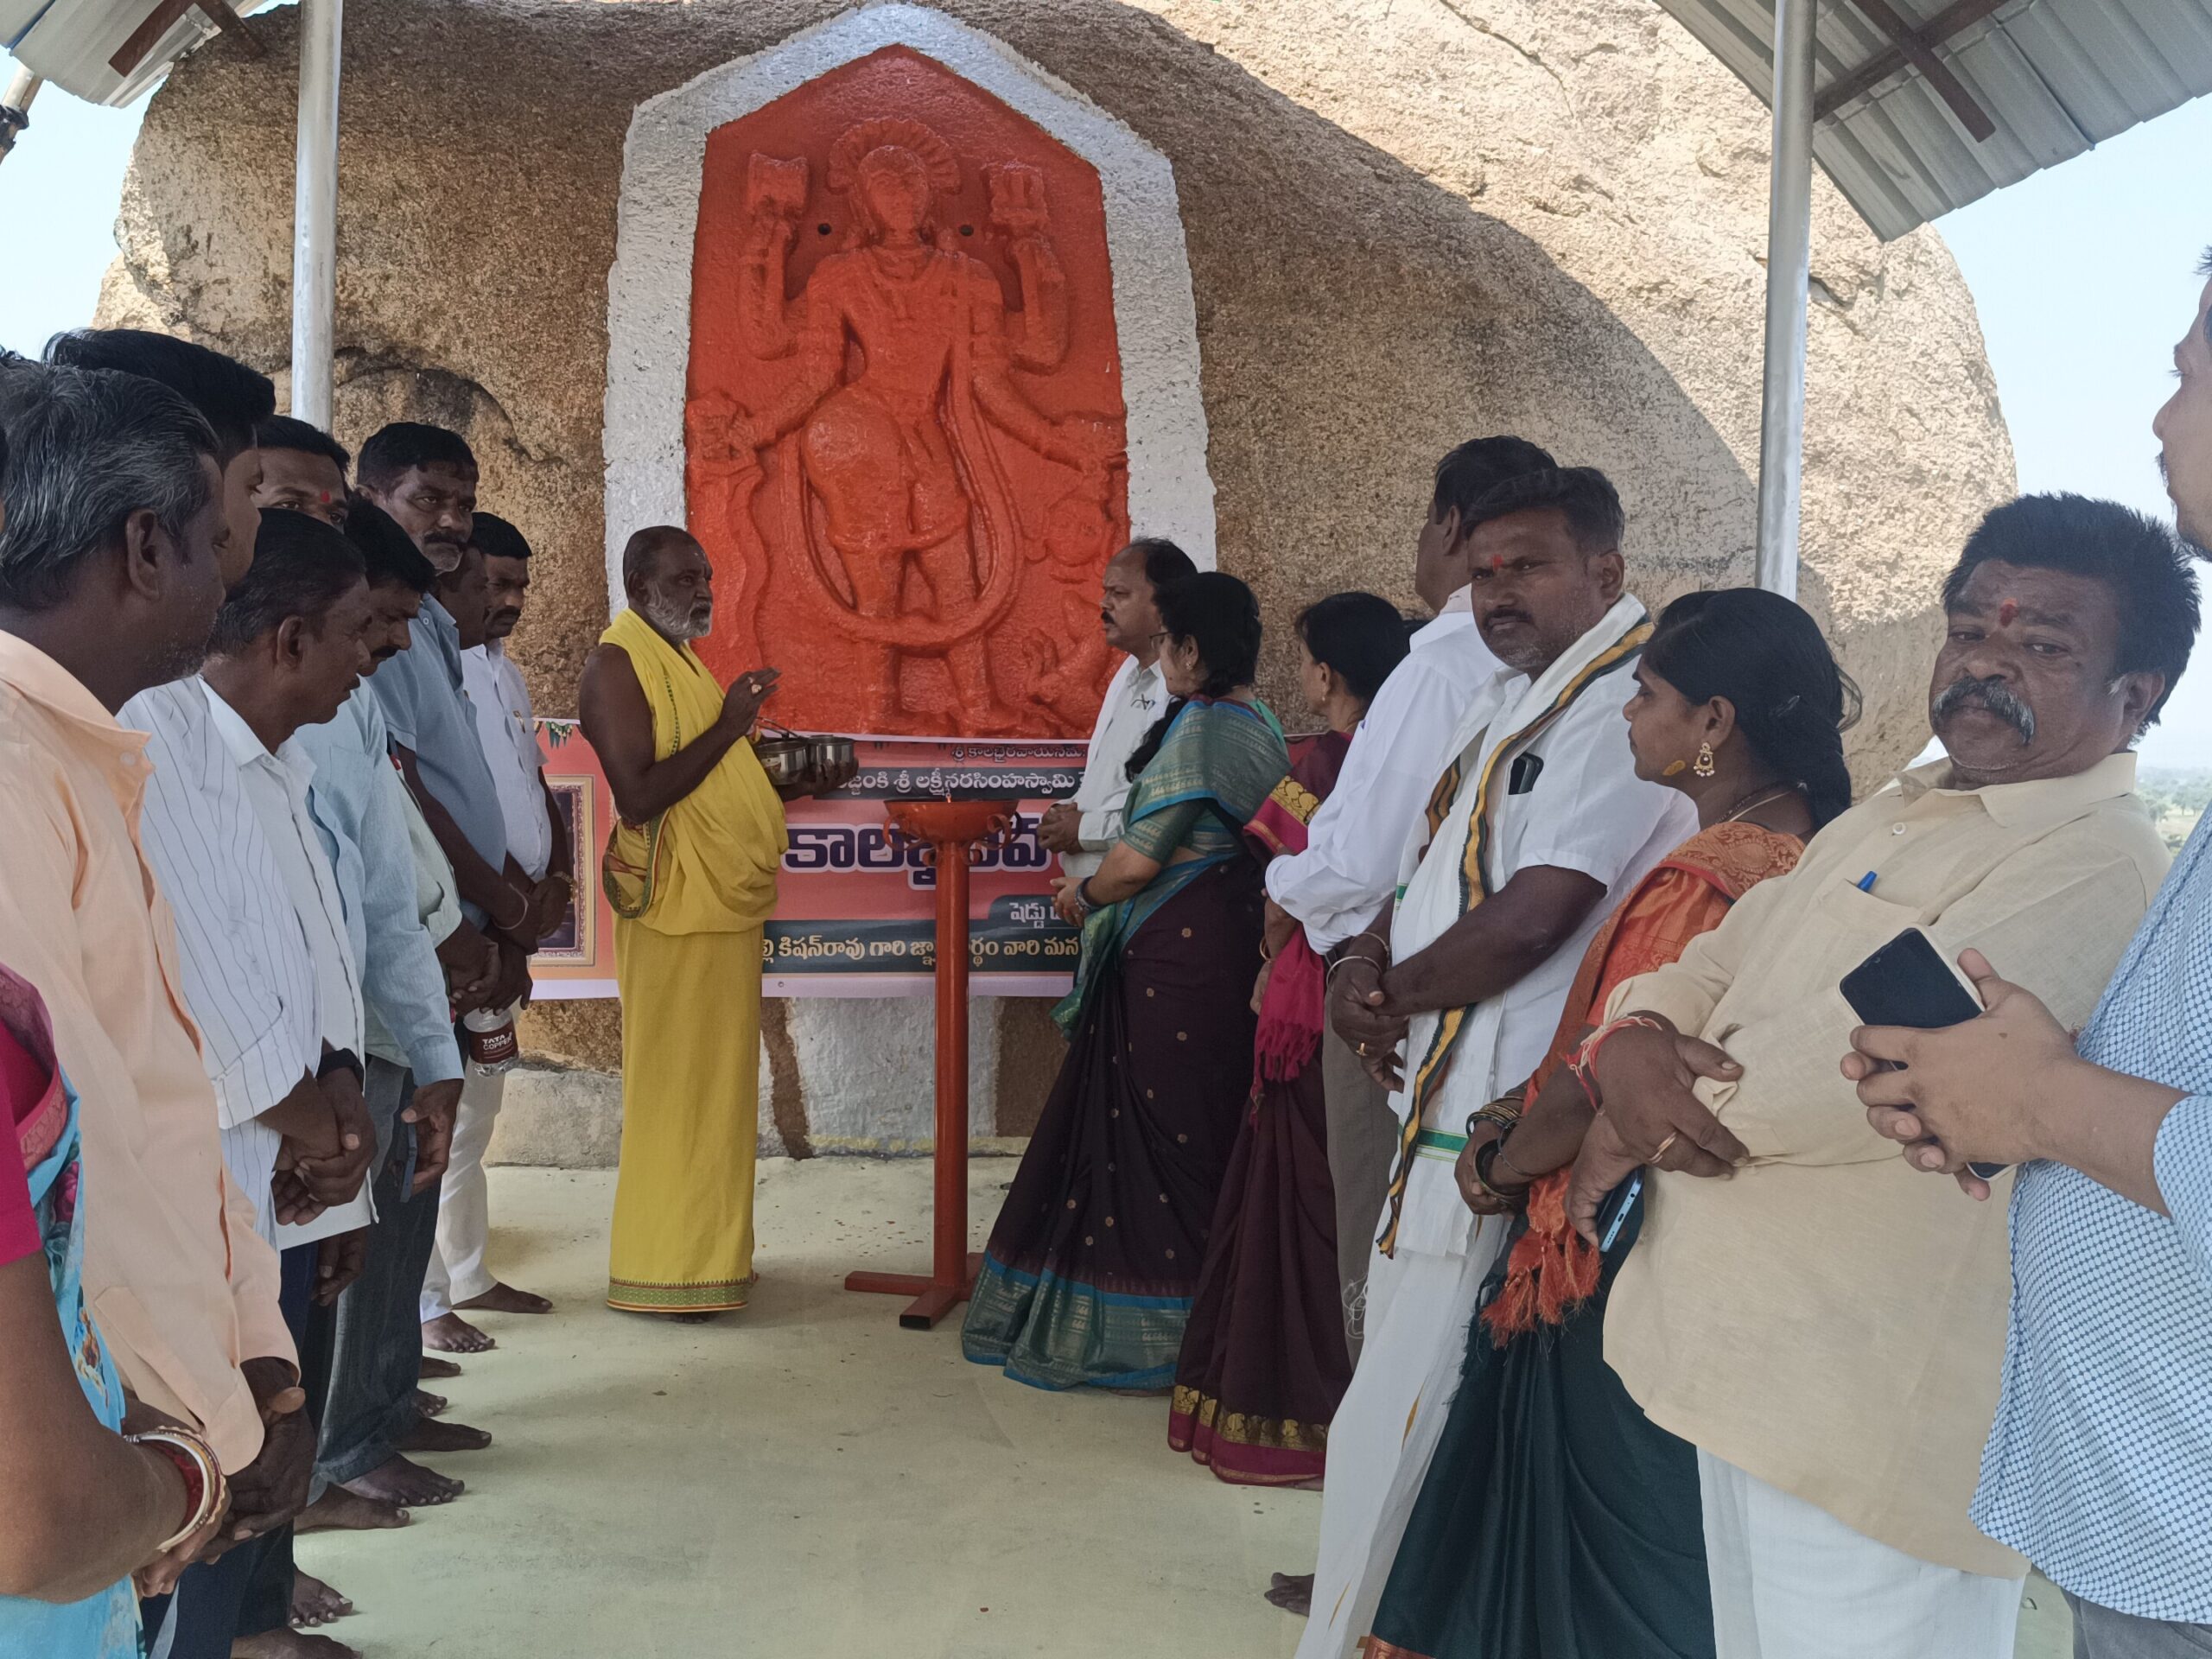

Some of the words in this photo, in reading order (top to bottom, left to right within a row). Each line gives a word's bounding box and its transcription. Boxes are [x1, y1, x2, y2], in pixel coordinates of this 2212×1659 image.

[837, 771, 889, 795] జ్జంకి
[893, 770, 912, 793] శ్రీ
[869, 940, 906, 957] గారి
[1003, 939, 1039, 956] వారి
[482, 1034, 505, 1045] TATA
